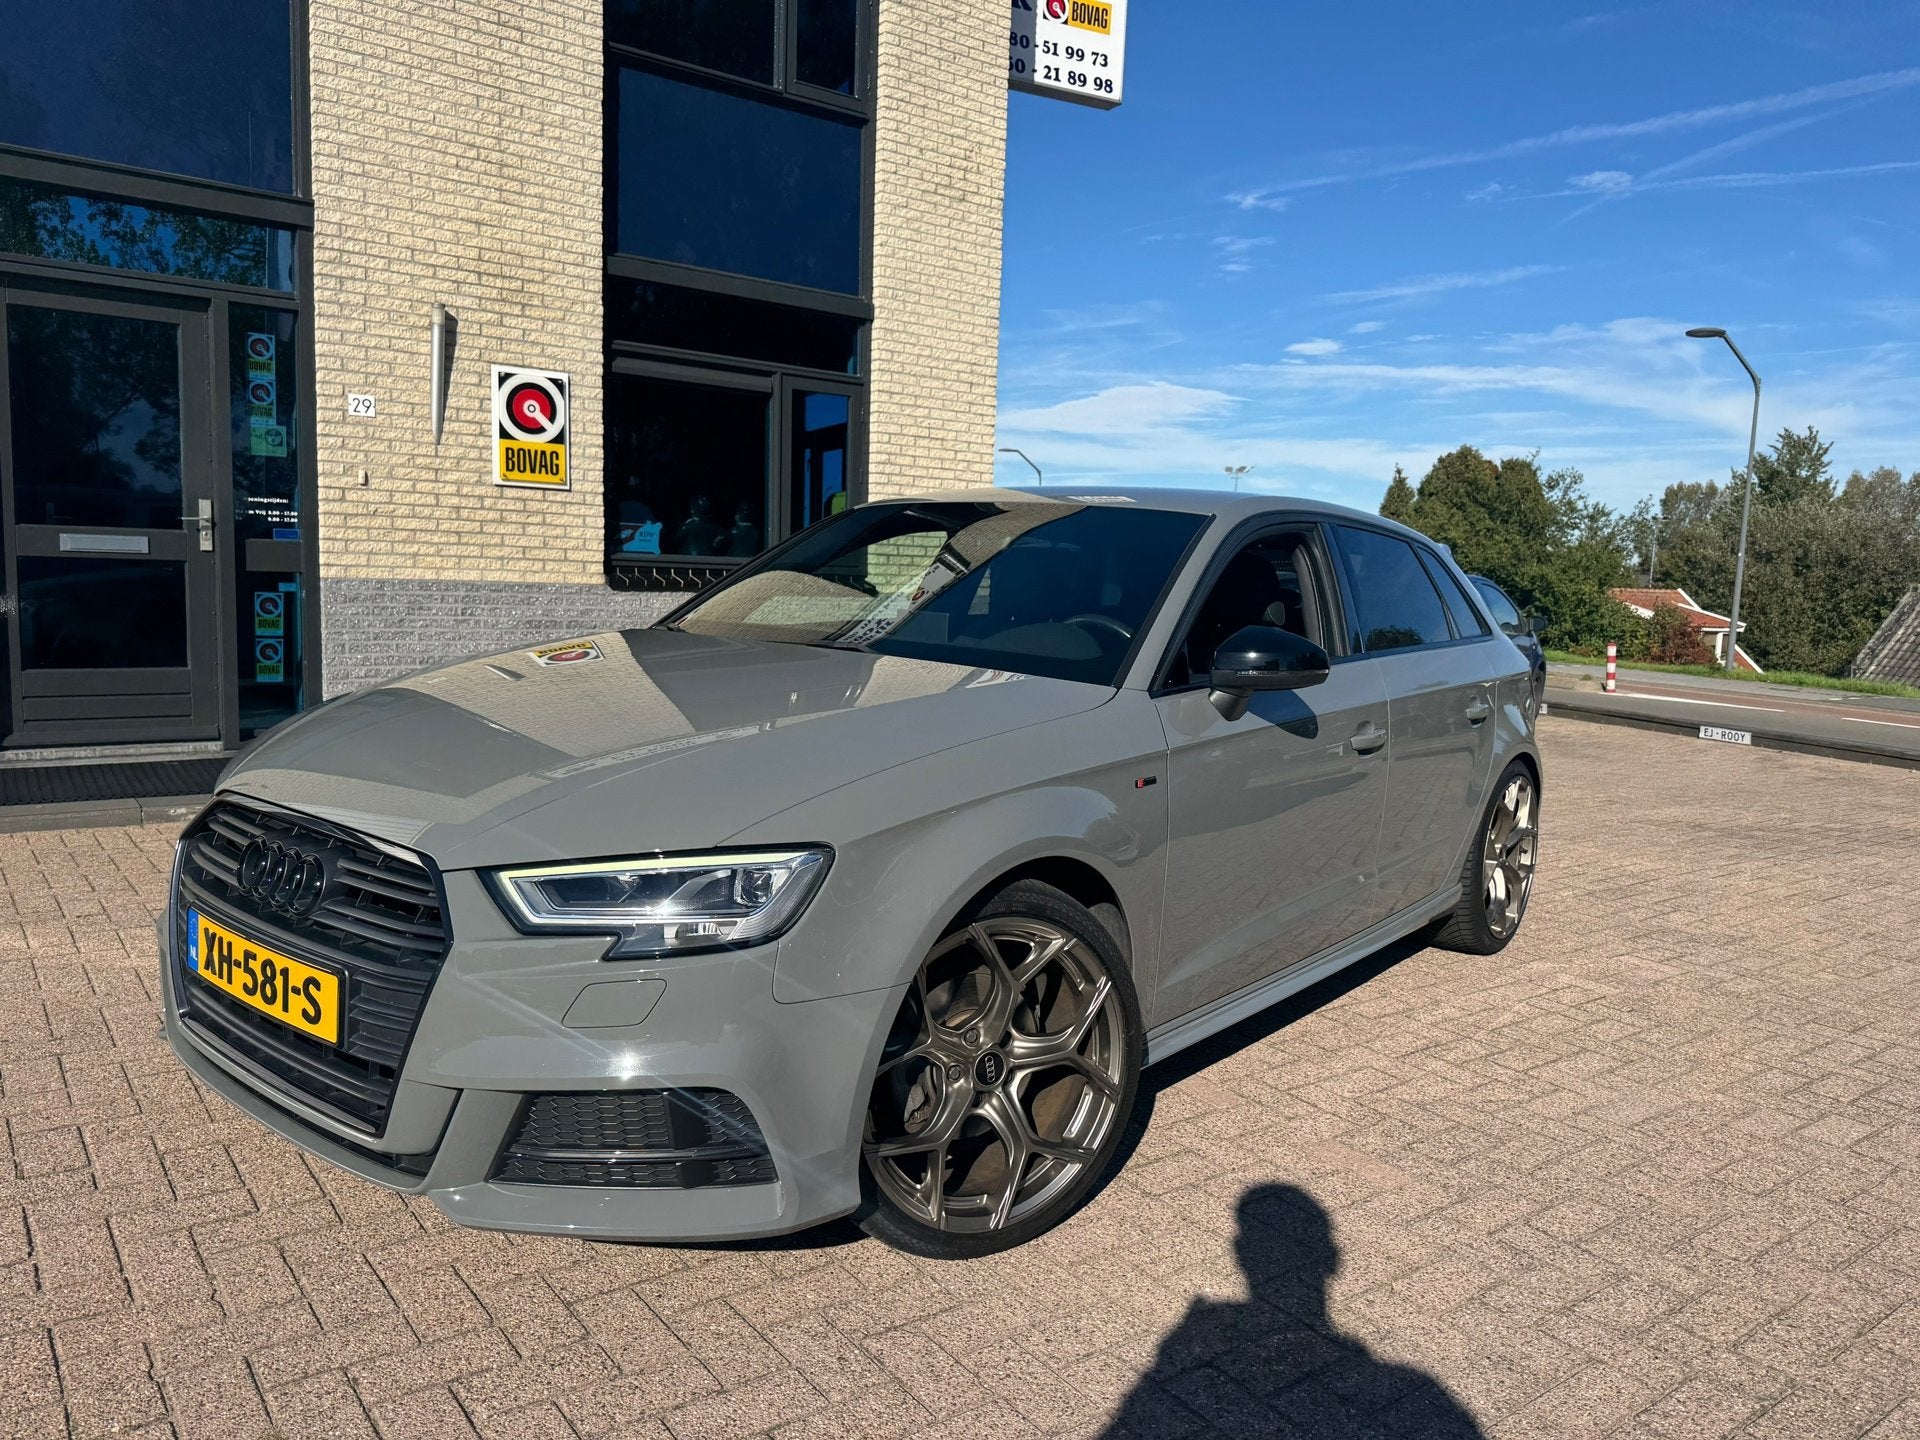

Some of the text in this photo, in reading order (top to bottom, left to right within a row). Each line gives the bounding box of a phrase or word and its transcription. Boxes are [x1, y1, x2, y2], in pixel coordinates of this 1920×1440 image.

[1072, 1, 1108, 29] BOVAG
[1065, 46, 1085, 62] 99
[1091, 51, 1108, 67] 73
[1043, 65, 1061, 82] 21
[1067, 70, 1087, 87] 89
[1093, 77, 1113, 93] 98
[352, 397, 372, 414] 29
[505, 446, 560, 476] BOVAG
[203, 927, 322, 1025] XH-581-S
